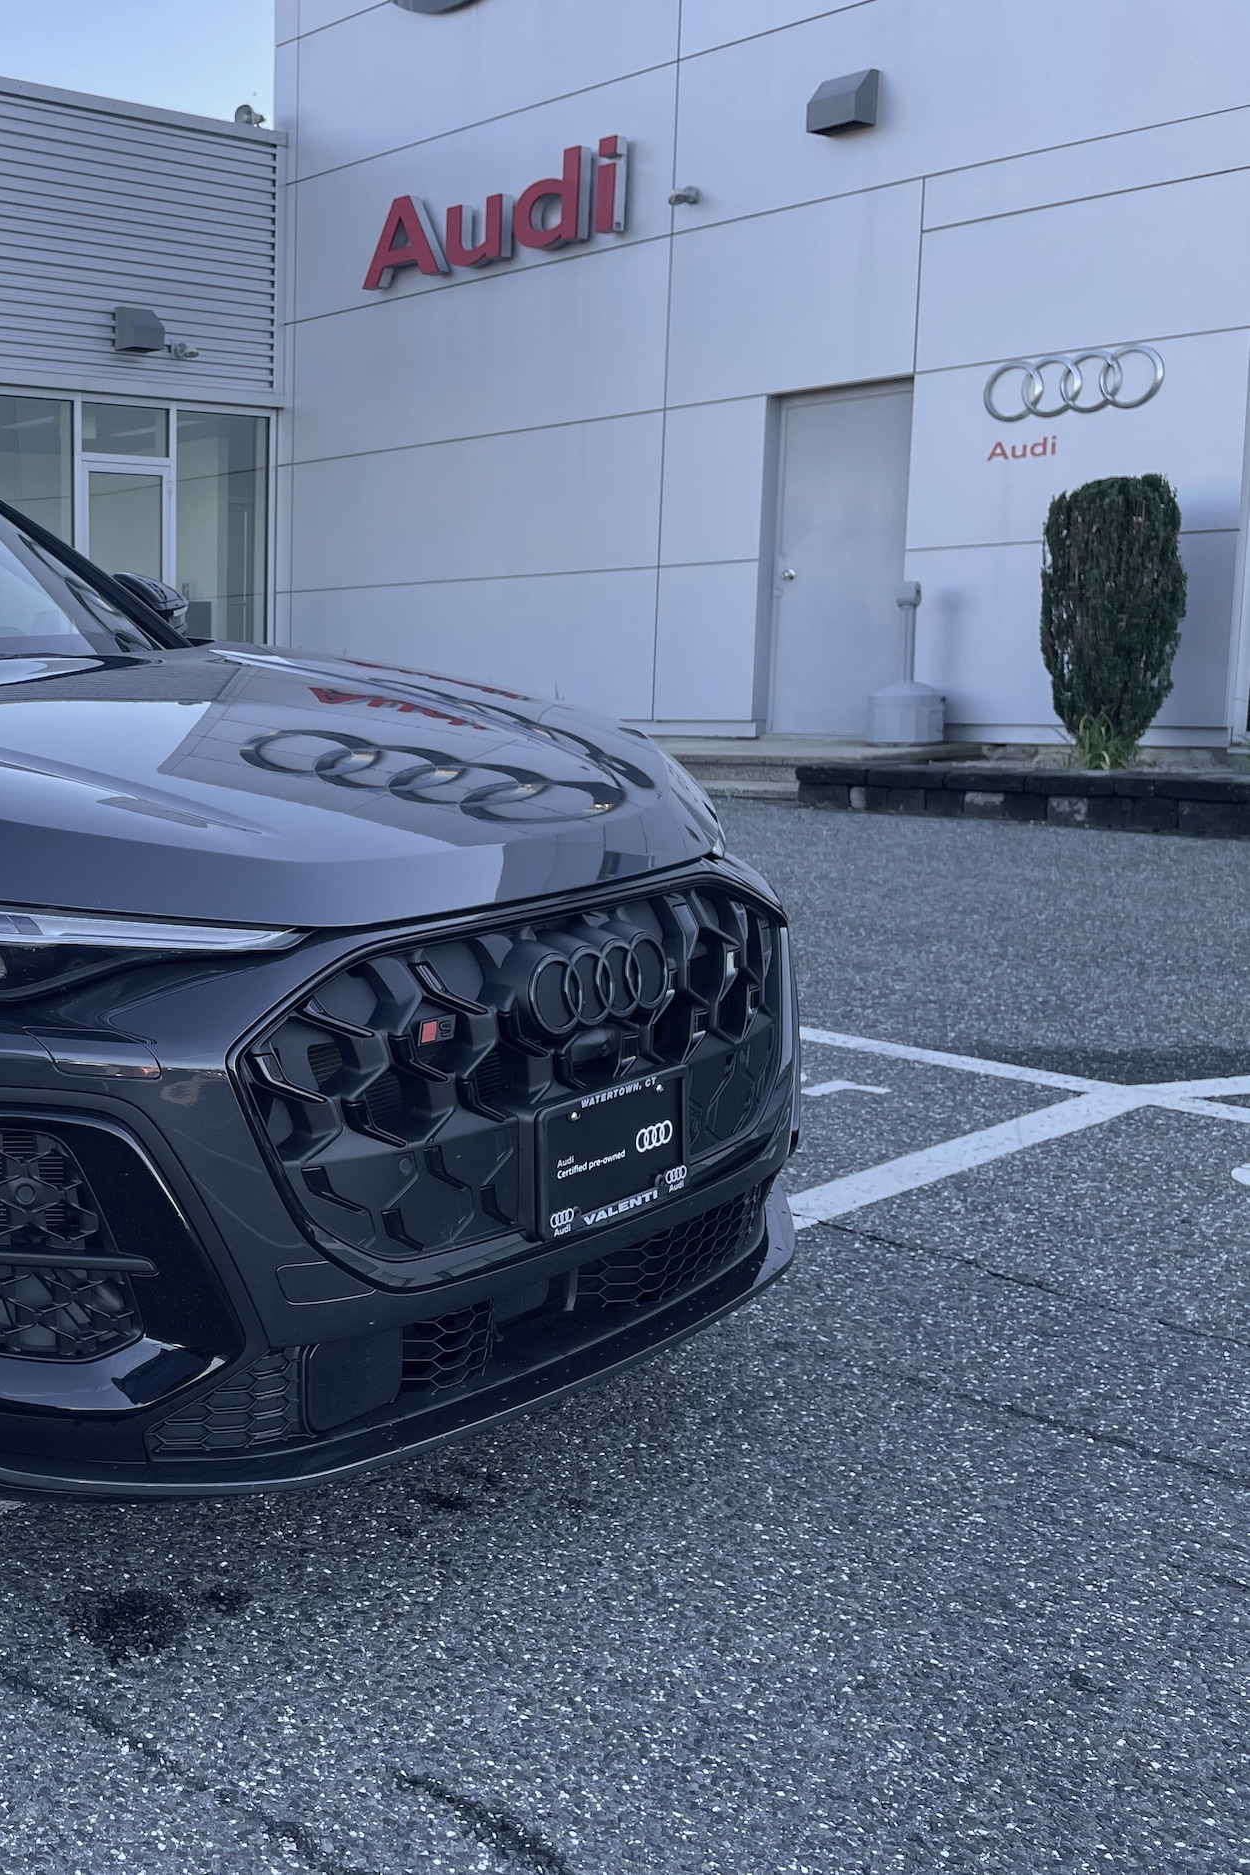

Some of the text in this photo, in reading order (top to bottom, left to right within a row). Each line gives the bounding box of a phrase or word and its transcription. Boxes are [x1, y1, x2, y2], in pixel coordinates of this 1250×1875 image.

[362, 134, 625, 290] Audi
[987, 435, 1058, 462] Audi
[580, 1076, 657, 1109] WATERTOWN, CT
[556, 1154, 575, 1169] Audi
[556, 1149, 626, 1180] Certified pre-owned
[668, 1180, 685, 1193] Audi
[582, 1188, 659, 1226] VALENTI
[553, 1223, 572, 1237] Audi
